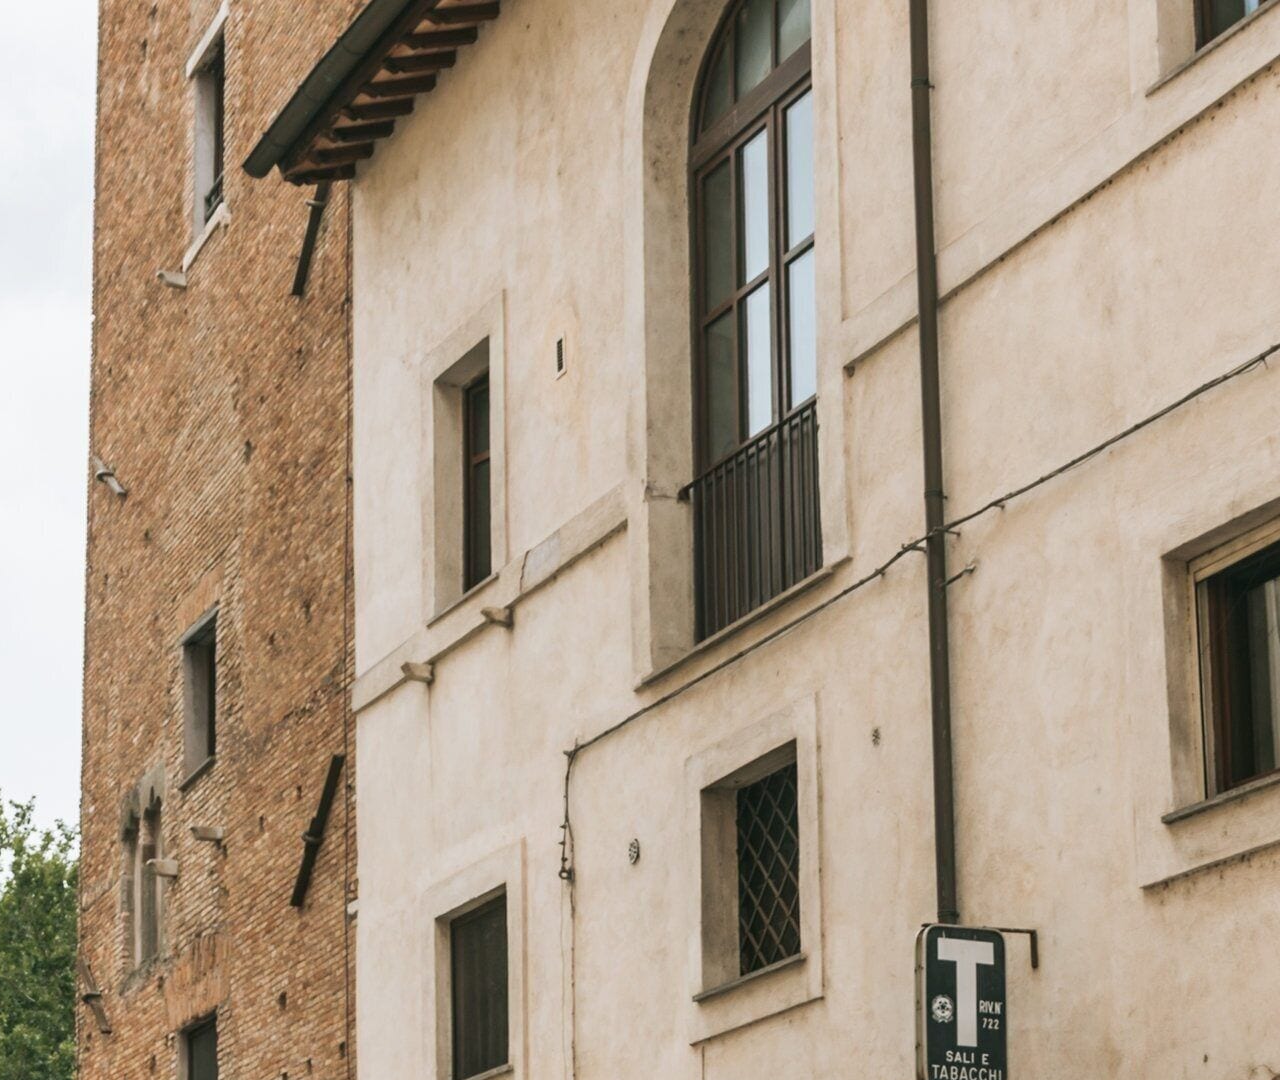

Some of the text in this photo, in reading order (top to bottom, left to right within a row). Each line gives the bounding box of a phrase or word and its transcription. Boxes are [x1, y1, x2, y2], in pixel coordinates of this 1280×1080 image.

[937, 937, 995, 1047] T
[982, 1018, 1000, 1030] 722
[945, 1050, 990, 1065] SALI E
